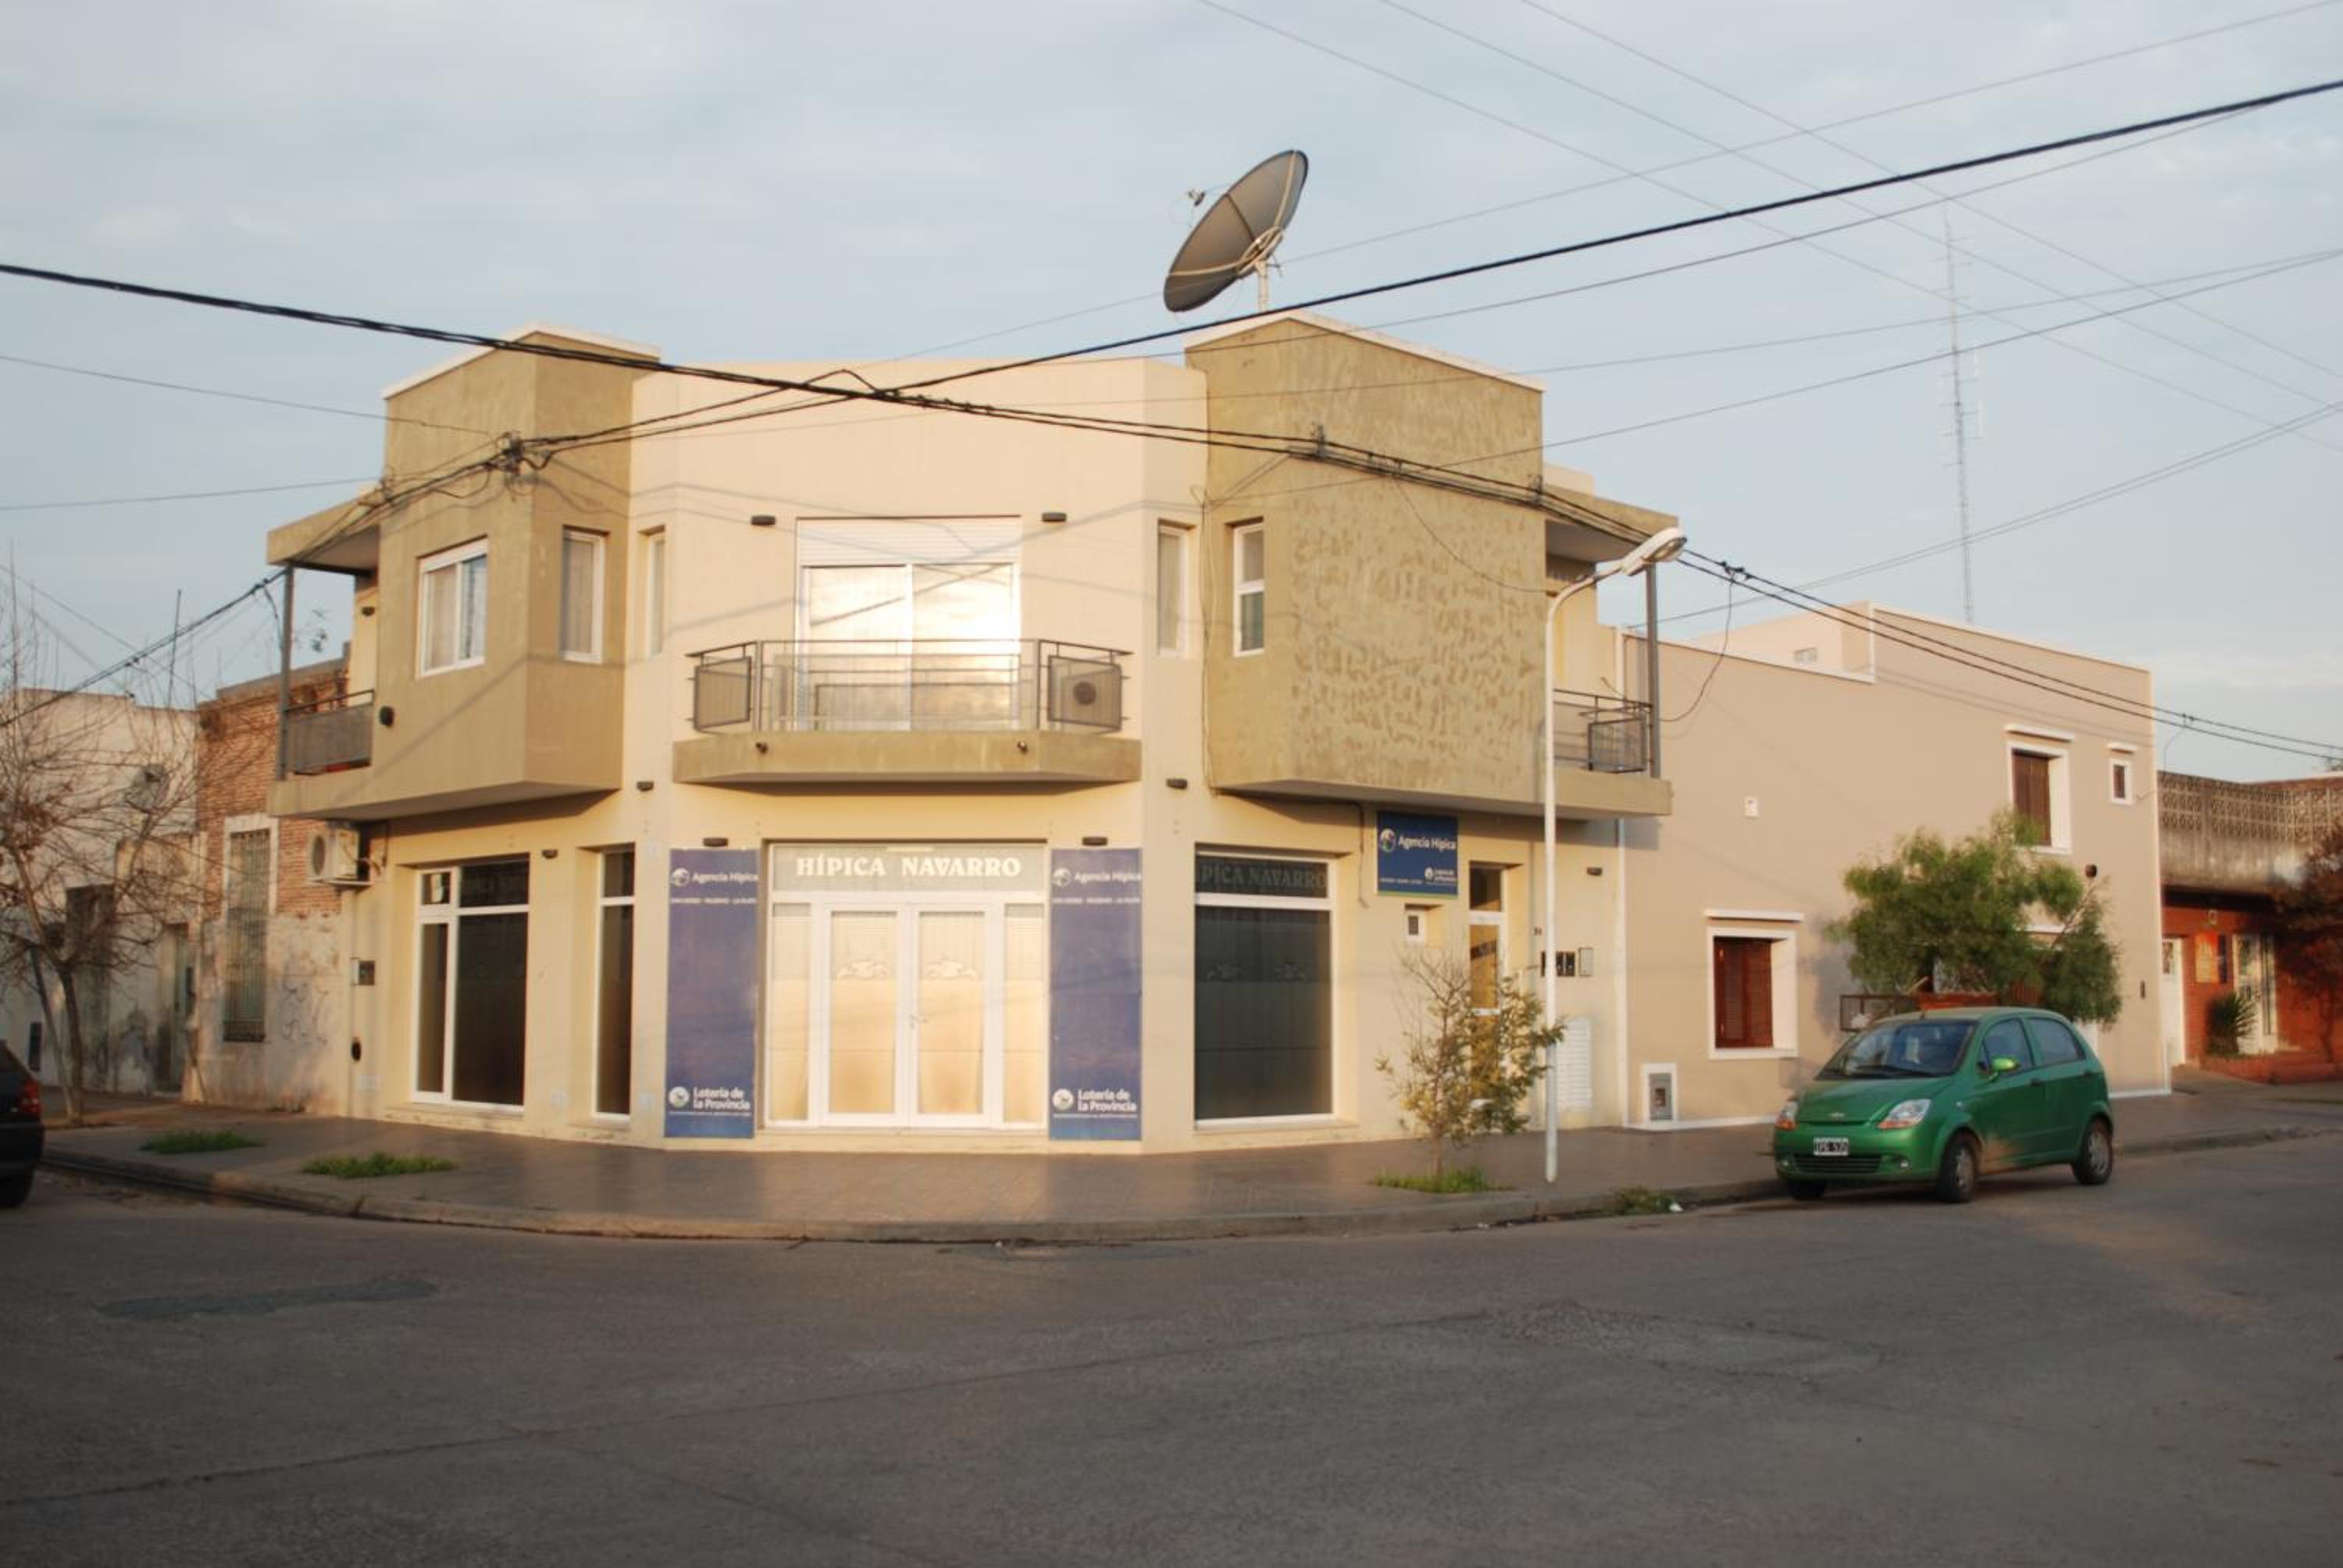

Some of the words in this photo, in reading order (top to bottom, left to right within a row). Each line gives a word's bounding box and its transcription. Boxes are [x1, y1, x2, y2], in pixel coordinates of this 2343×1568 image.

[1399, 835, 1429, 850] Agencia
[796, 852, 886, 876] HÍPICA
[900, 857, 1022, 876] NAVARRO
[692, 871, 728, 884] Agencia
[1075, 871, 1110, 884] Agencia
[1196, 862, 1246, 885] PICA
[1250, 868, 1327, 889] NAVARRO
[730, 1086, 744, 1099] de
[1116, 1089, 1130, 1100] de
[704, 1099, 751, 1110] Provincia
[1089, 1101, 1137, 1112] Provincia
